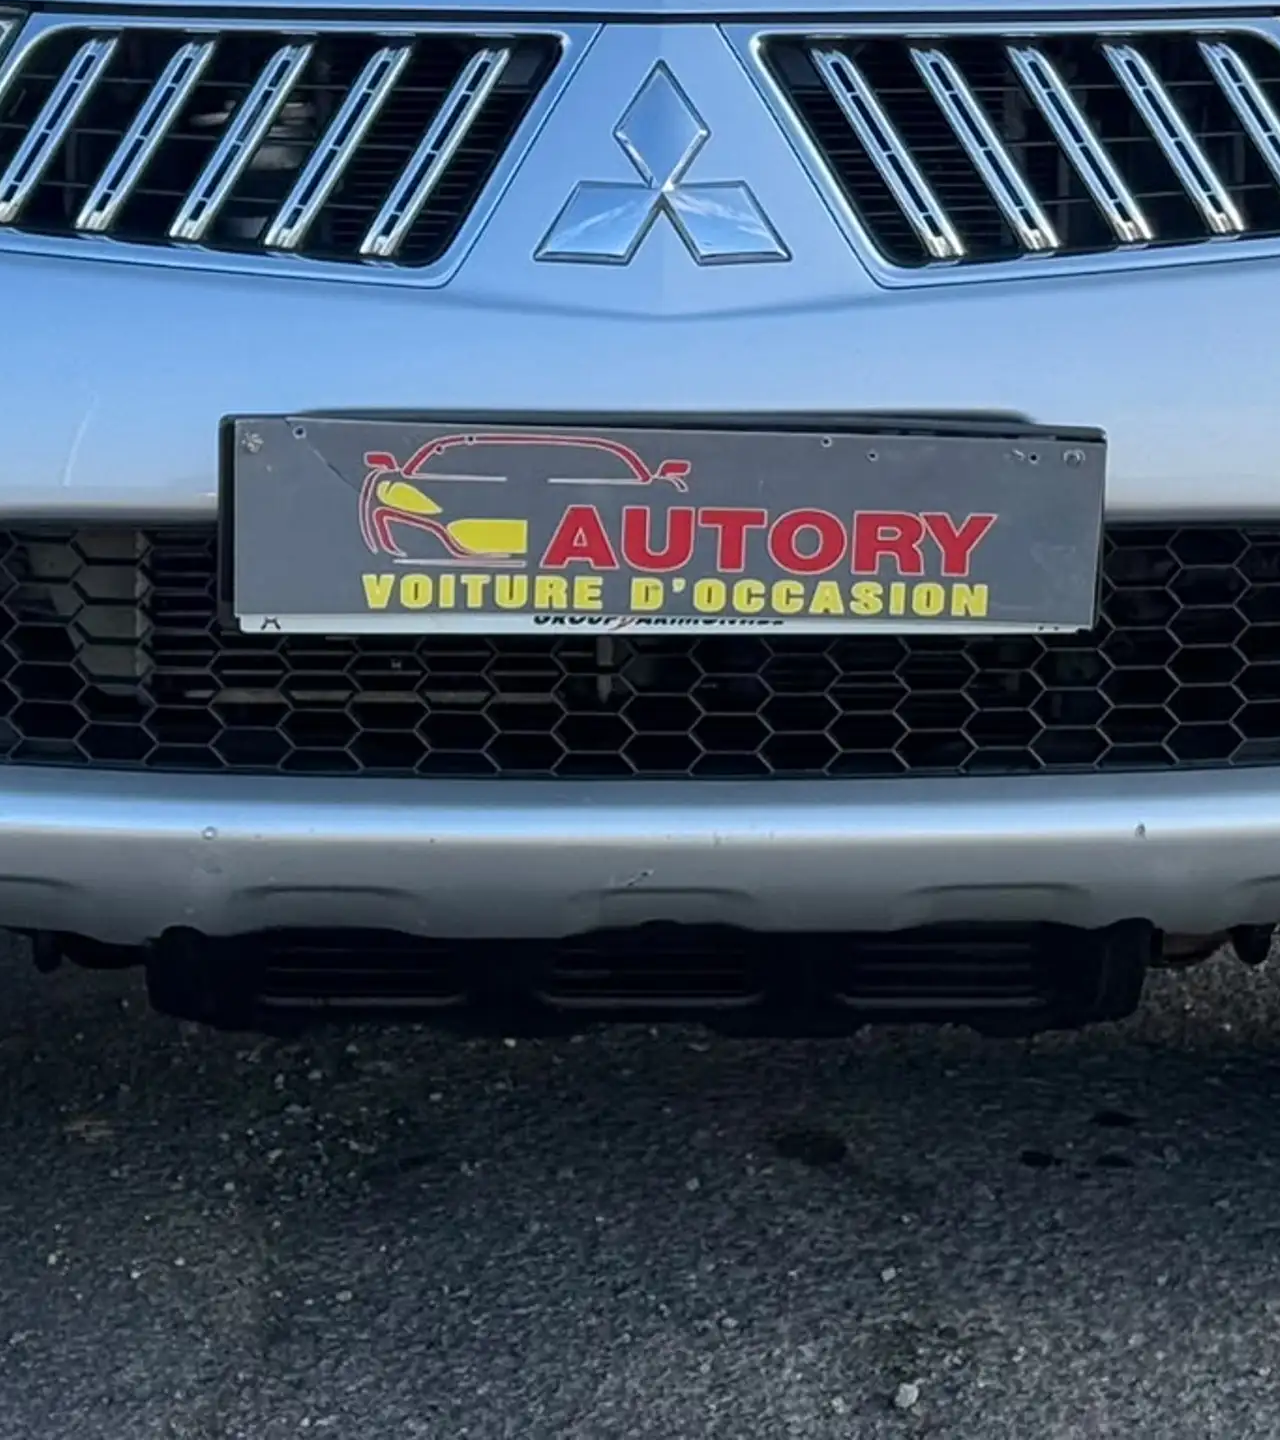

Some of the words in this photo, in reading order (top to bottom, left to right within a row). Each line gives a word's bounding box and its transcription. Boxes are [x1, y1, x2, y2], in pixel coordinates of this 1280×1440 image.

[540, 505, 998, 577] AUTORY
[362, 573, 604, 609] VOITURE
[630, 577, 989, 617] D'OCCASION
